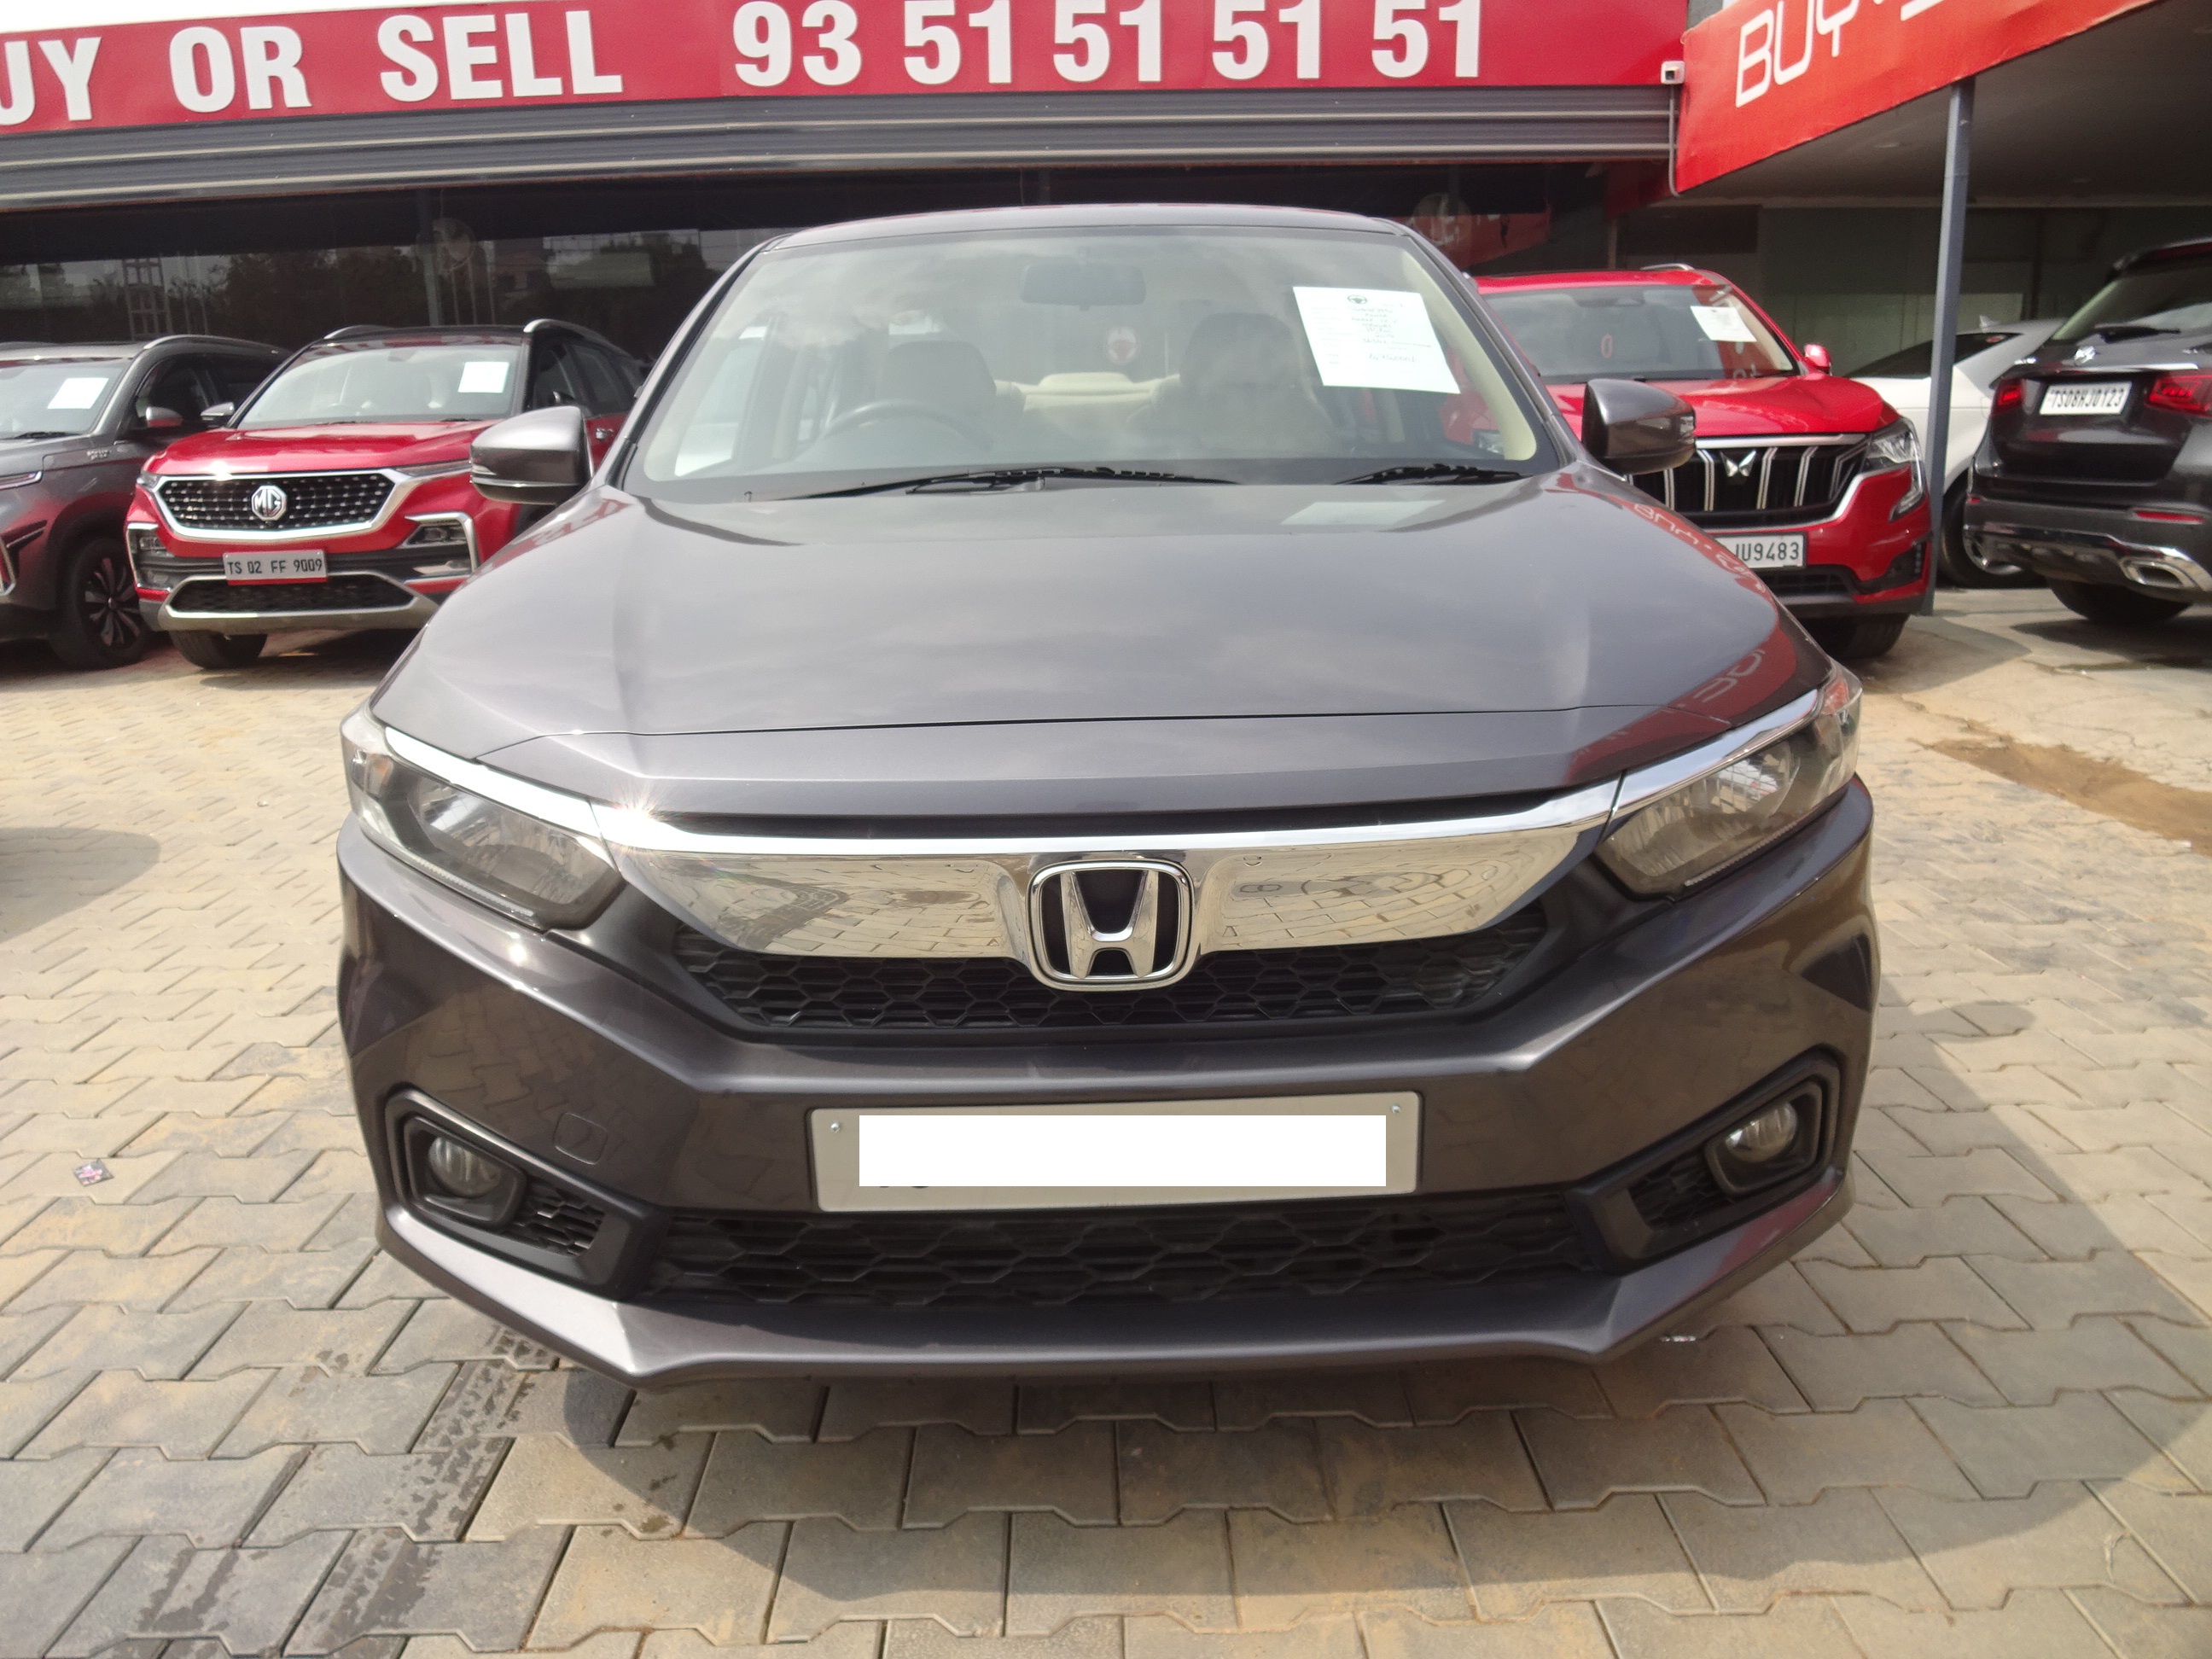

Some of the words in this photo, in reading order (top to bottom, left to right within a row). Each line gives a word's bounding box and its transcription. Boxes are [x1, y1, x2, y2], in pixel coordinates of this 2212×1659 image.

[170, 26, 312, 113] OR
[377, 9, 623, 102] SELL
[733, 0, 862, 87] 93
[904, 0, 1012, 84] 51
[1053, 0, 1161, 83] 51
[1212, 0, 1321, 80] 51
[1371, 0, 1481, 79] 51
[1735, 0, 1860, 108] BUY
[253, 489, 282, 516] MG
[227, 561, 242, 575] TS
[247, 561, 263, 574] 02
[270, 560, 286, 573] FF
[293, 558, 323, 573] 9009
